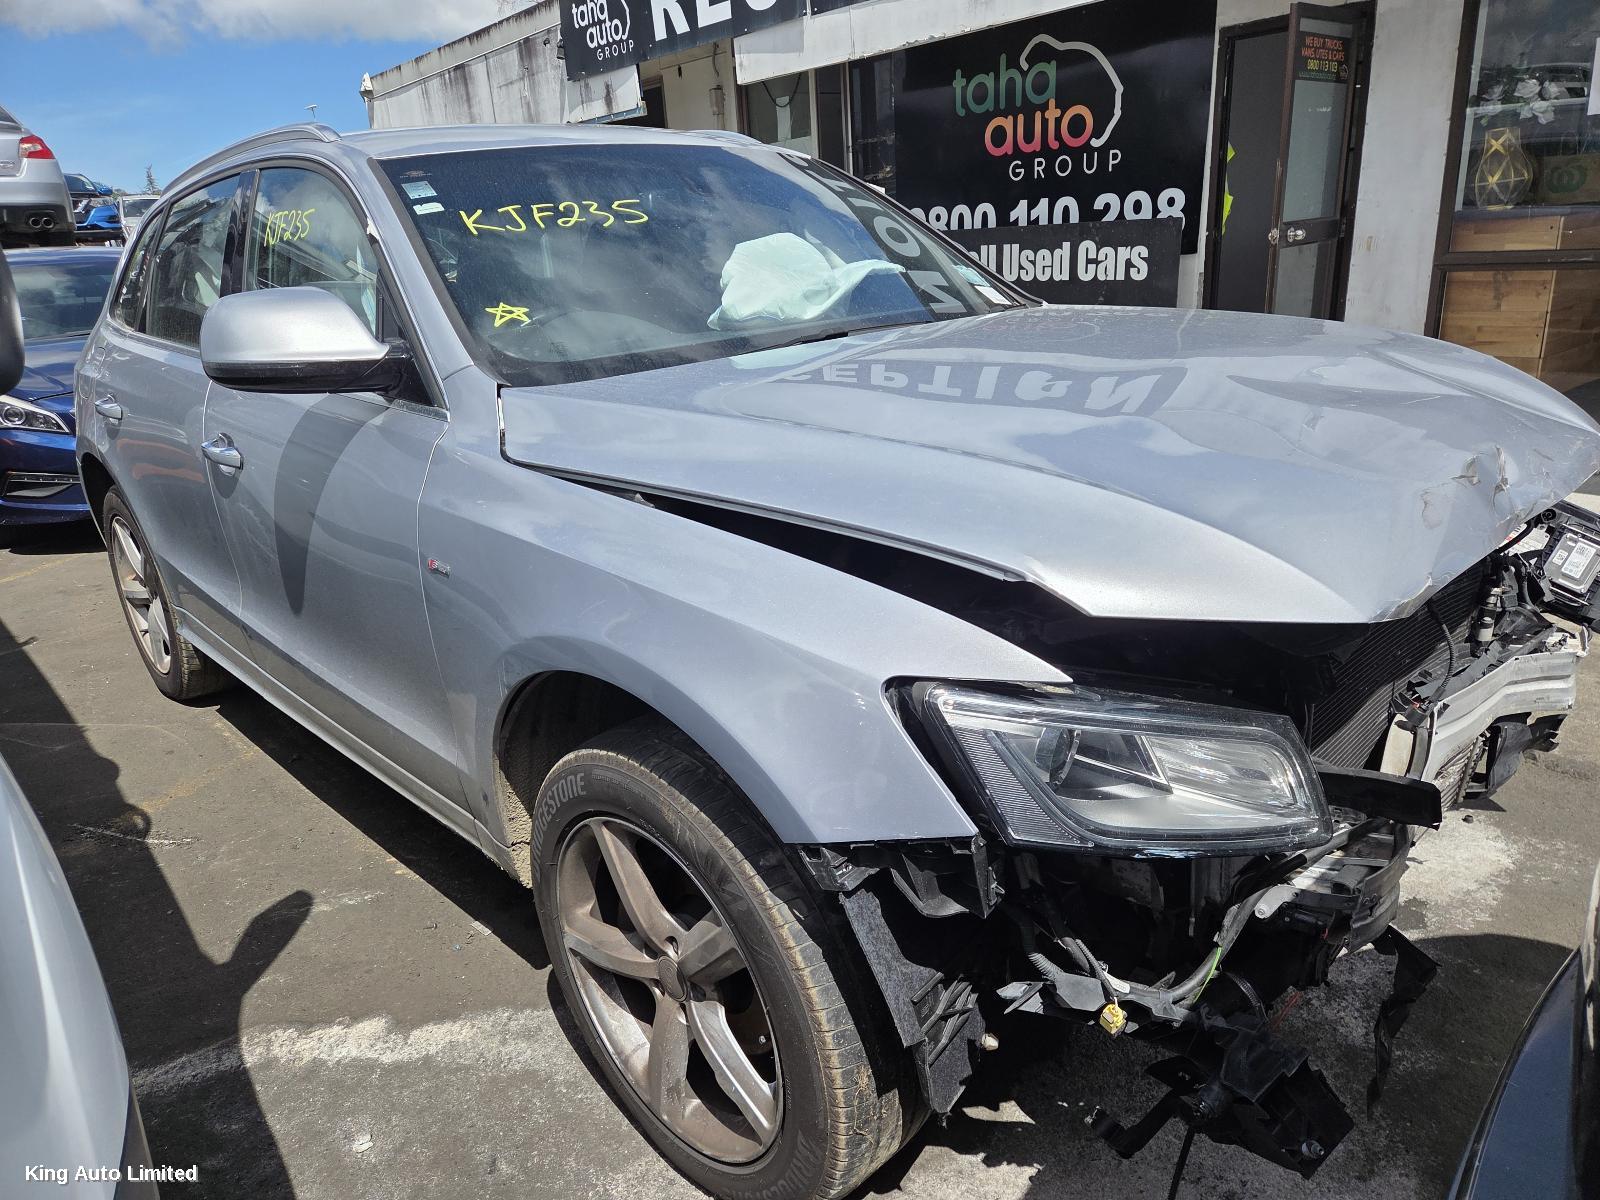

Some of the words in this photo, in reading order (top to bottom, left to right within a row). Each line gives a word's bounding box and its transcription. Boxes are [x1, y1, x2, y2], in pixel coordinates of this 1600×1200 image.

[586, 18, 623, 49] auto
[597, 40, 634, 61] GROUP
[952, 53, 1057, 117] taha
[984, 98, 1094, 157] auto
[1008, 149, 1122, 182] GROUP
[459, 199, 649, 236] KJF235
[1009, 196, 1080, 226] 110
[1093, 188, 1186, 225] 298
[1002, 241, 1070, 282] Used
[1077, 239, 1149, 282] Cars
